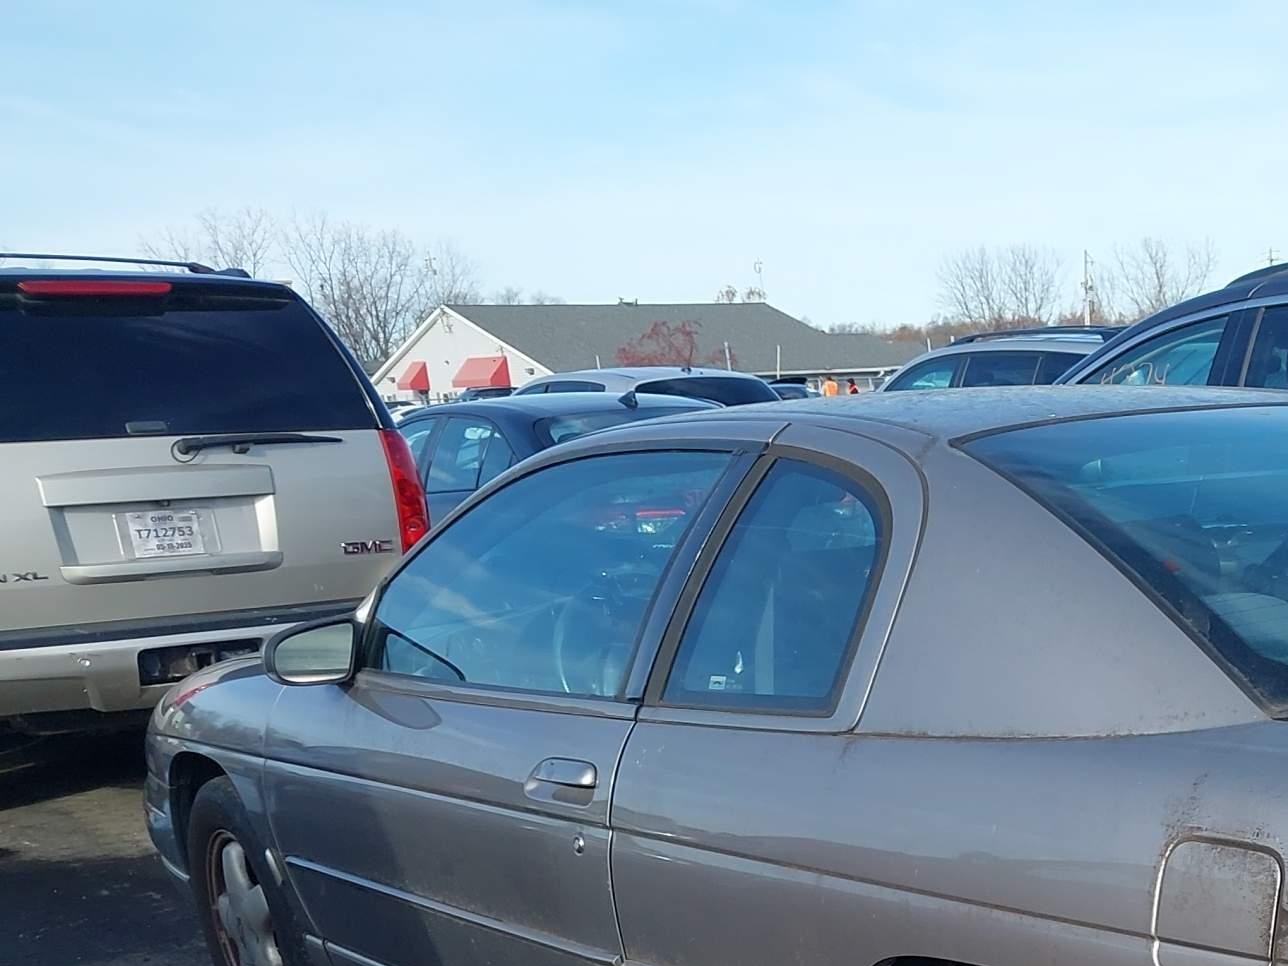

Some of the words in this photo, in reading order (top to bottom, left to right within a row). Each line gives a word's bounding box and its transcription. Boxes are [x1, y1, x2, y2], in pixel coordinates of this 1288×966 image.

[134, 526, 194, 539] T712753
[340, 540, 392, 554] GMC
[11, 571, 49, 583] XL
